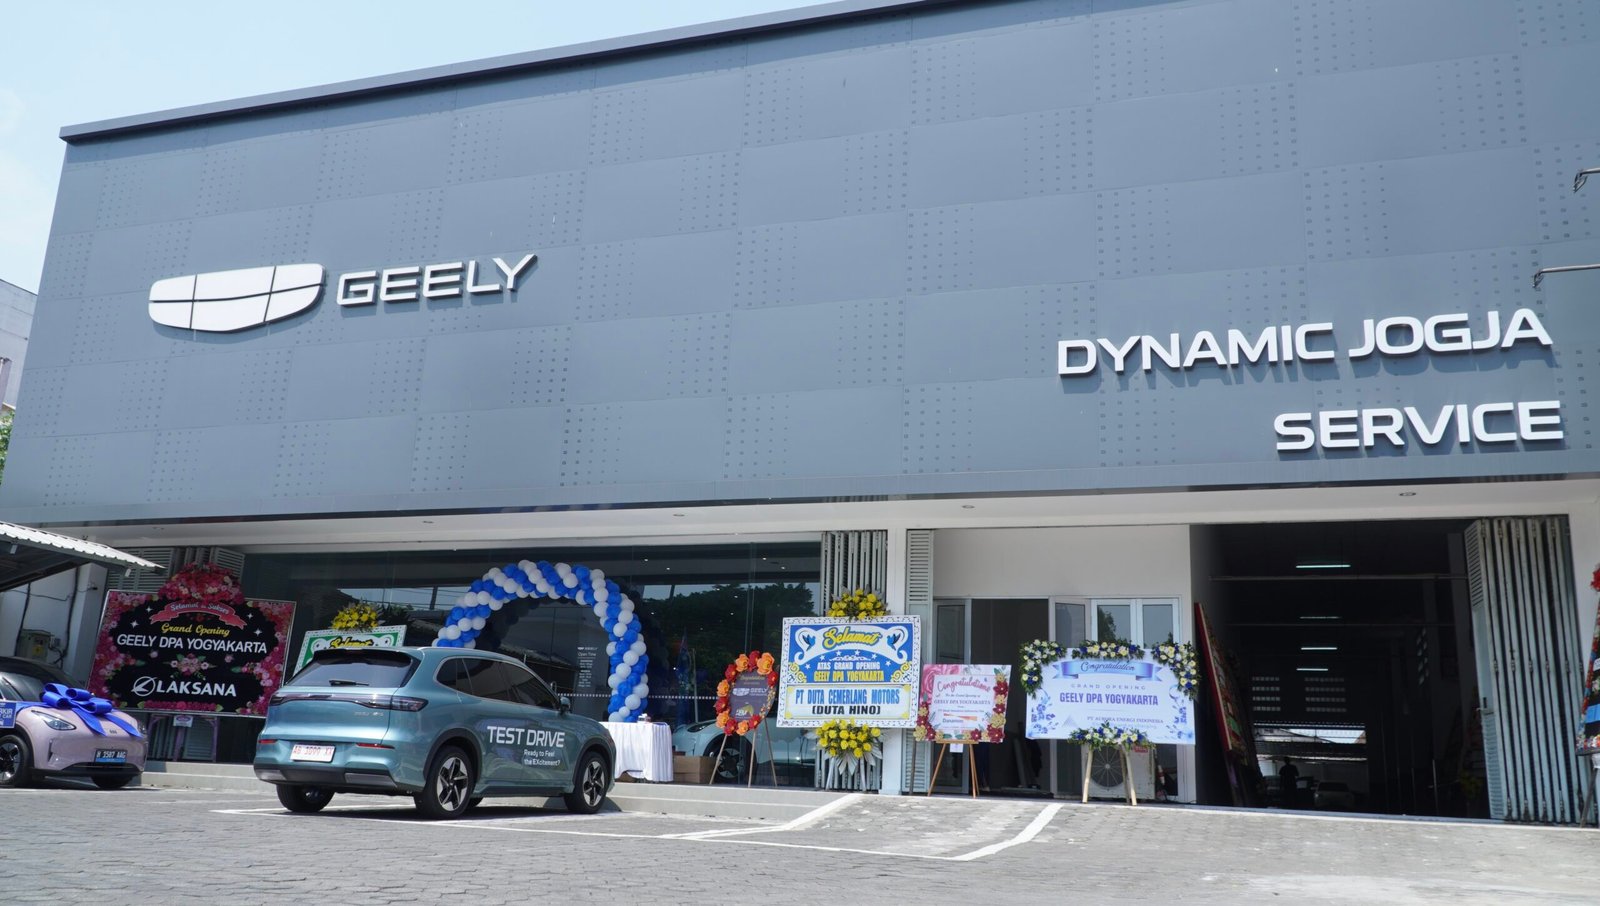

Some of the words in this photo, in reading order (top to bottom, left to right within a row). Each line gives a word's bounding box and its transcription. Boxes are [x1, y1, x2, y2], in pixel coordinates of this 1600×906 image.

[336, 254, 538, 306] GEELY
[1057, 322, 1335, 376] DYNAMIC
[1349, 308, 1553, 359] JOGJA
[1273, 400, 1564, 451] SERVICE
[170, 602, 199, 612] Selamat
[207, 603, 230, 615] Sukses
[161, 622, 192, 634] Grand
[195, 624, 231, 638] Opening
[822, 626, 882, 650] Selamat
[116, 633, 157, 647] GEELY
[159, 636, 184, 649] DPA
[187, 637, 268, 654] YOGYAKARTA
[816, 661, 832, 670] ATAS
[833, 661, 854, 670] GRAND
[855, 661, 881, 670] OPENING
[813, 670, 830, 681] GEELY
[832, 670, 845, 681] DPA
[846, 670, 885, 681] YOGYAKARTA
[156, 680, 237, 697] LAKSANA
[795, 689, 805, 705] PT
[807, 689, 825, 705] DUTA
[828, 689, 868, 705] CEMERLANG
[871, 689, 900, 705] MOTORS
[1059, 692, 1084, 704] GEELY
[1086, 692, 1103, 704] DPA
[1105, 693, 1159, 706] YOGYAKARTA
[811, 705, 845, 715] (DUTA
[848, 705, 881, 715] HINO)
[486, 725, 525, 745] TEST
[526, 729, 566, 748] DRIVE
[524, 749, 538, 758] Ready
